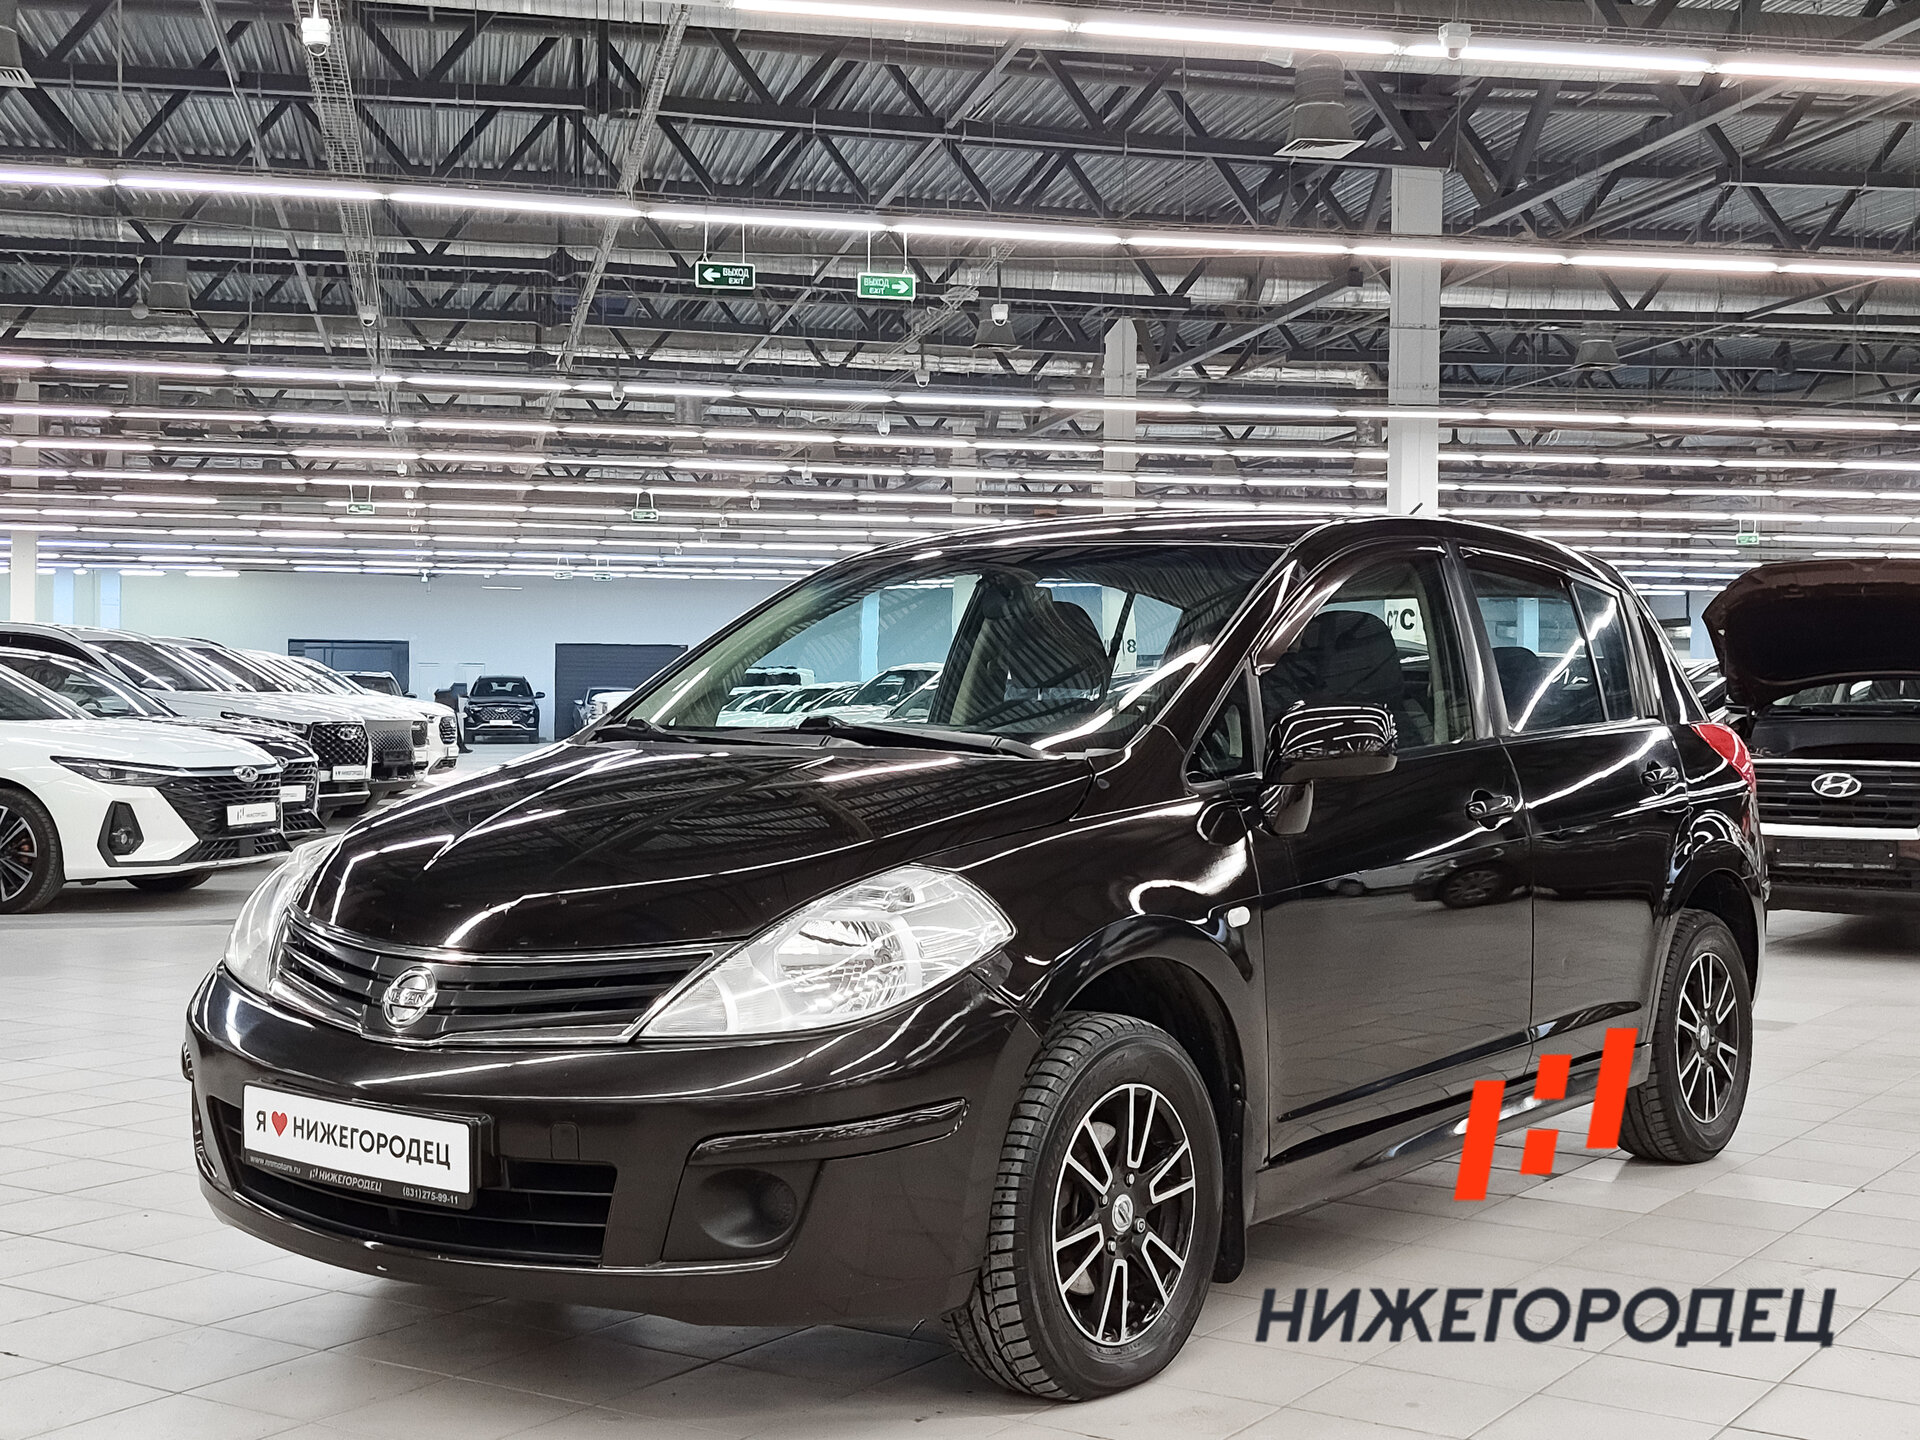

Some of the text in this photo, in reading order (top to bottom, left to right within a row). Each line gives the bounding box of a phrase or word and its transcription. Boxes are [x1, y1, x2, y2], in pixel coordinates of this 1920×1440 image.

[722, 267, 750, 278] ВЫХОД
[728, 277, 744, 285] EXIT
[863, 277, 890, 289] ВЫХОД
[868, 287, 885, 295] EXIT
[256, 1110, 451, 1171] Я НИЖЕГОРОДЕЦ
[319, 1170, 383, 1193] НИЖЕГОРОДЕЦ
